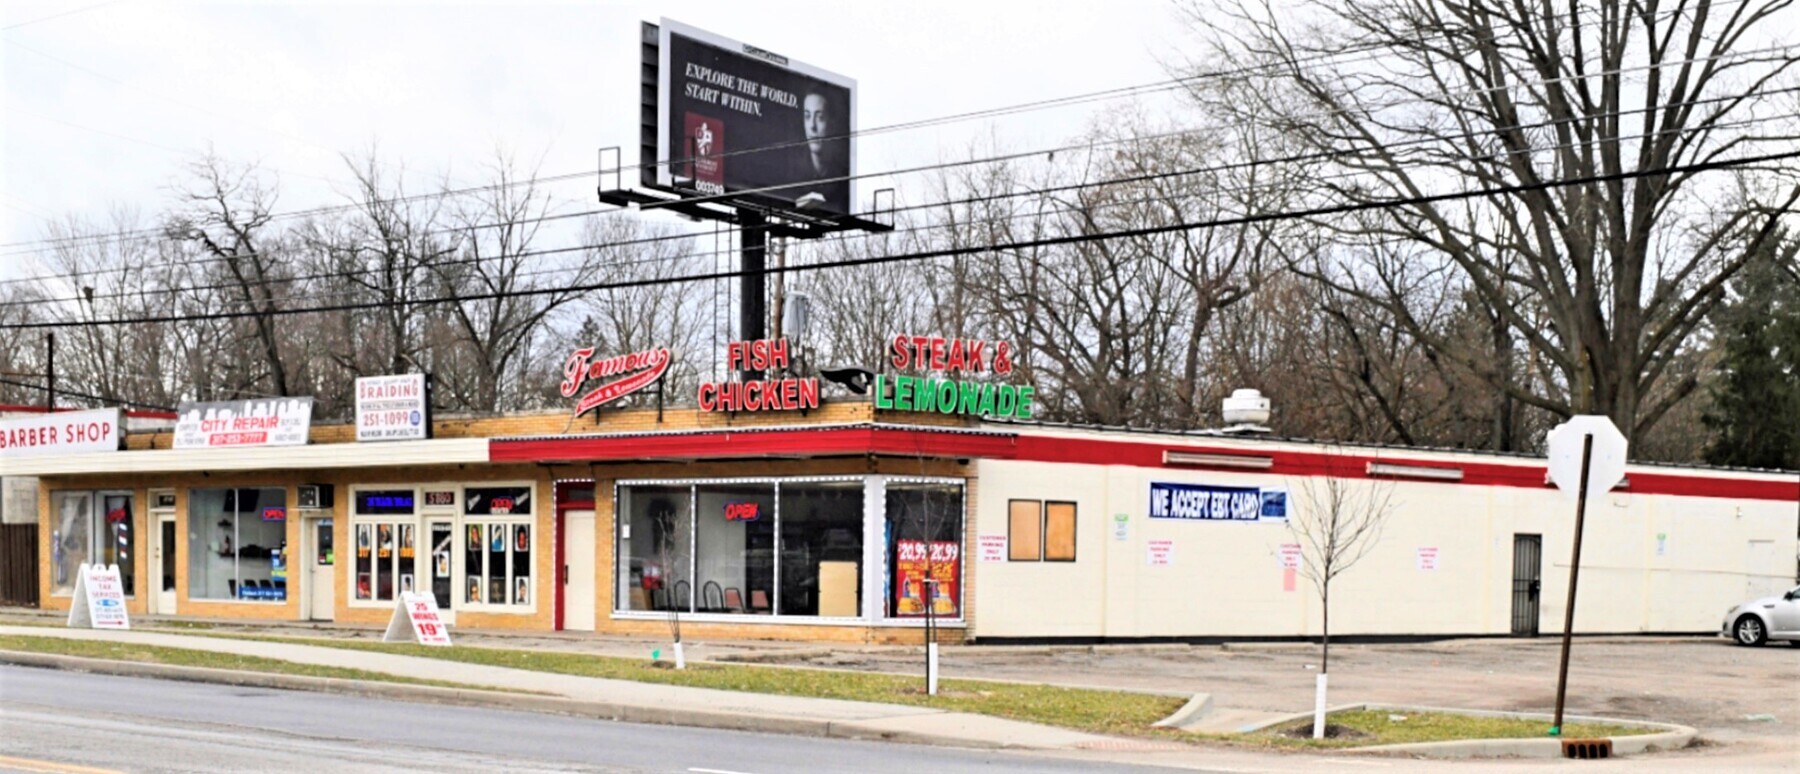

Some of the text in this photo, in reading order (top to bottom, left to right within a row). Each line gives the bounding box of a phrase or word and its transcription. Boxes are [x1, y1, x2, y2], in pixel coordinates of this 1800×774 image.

[685, 62, 798, 109] EXPLORE THE WORLD.
[685, 82, 762, 117] START WITHIN.
[727, 336, 789, 371] FISH
[892, 334, 1012, 375] STEAK &
[561, 346, 660, 397] Famous
[360, 378, 419, 399] BRAIDING
[698, 377, 820, 412] CHICKEN
[875, 374, 1035, 419] LEMONADE
[201, 419, 228, 432] CITY
[233, 415, 279, 430] REPAIR
[363, 411, 409, 426] 251-1099
[0, 422, 111, 448] BARBER SHOP
[264, 509, 285, 519] OPEN
[725, 503, 758, 520] OPEN
[1152, 488, 1169, 516] WE
[1170, 489, 1210, 518] ACCEPT
[1210, 491, 1230, 518] EBT
[1231, 492, 1259, 519] CARD
[415, 602, 427, 610] 25
[418, 623, 437, 635] 19
